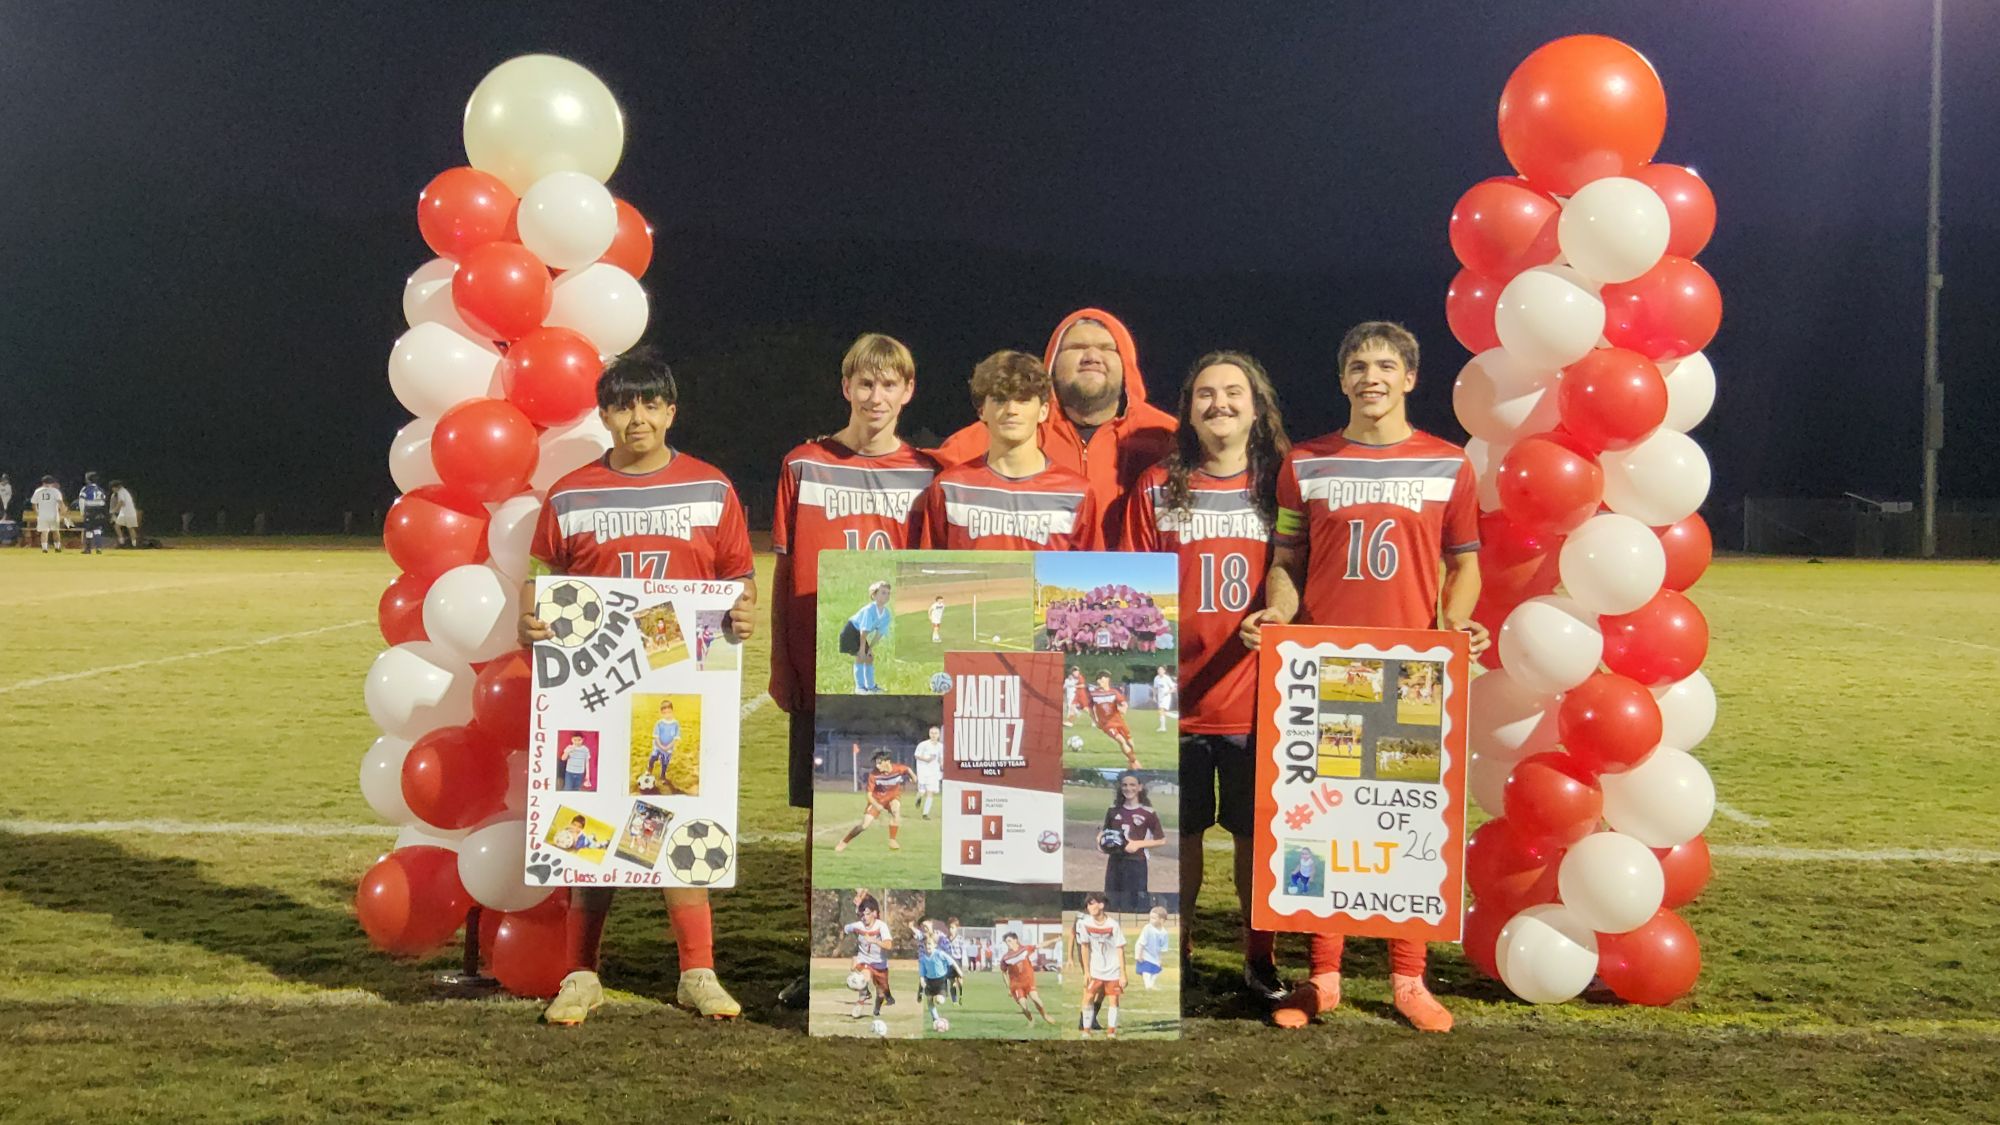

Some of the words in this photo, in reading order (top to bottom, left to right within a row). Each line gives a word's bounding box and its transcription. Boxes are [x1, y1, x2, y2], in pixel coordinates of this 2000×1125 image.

[824, 488, 911, 524] COUGARS
[1328, 480, 1424, 513] COUGARS
[594, 505, 691, 544] COUGARS
[968, 508, 1051, 546] COUGARS
[1342, 518, 1398, 581] 16
[643, 580, 678, 594] Class
[683, 583, 697, 595] of
[701, 582, 734, 595] 2026
[1197, 552, 1250, 613] 18
[533, 590, 640, 689] Danny
[580, 648, 642, 713] #17
[954, 675, 1021, 718] JADEN
[953, 718, 1024, 761] NUNEZ
[1008, 760, 1027, 768] TEAM
[1284, 783, 1344, 831] #16
[1354, 786, 1439, 810] CLASS
[1377, 811, 1411, 831] OF
[1330, 839, 1400, 875] LLJ
[1402, 829, 1438, 862] 26
[564, 867, 598, 884] Class
[602, 868, 618, 883] of
[625, 871, 662, 885] 2026
[1330, 891, 1443, 916] DANCER
